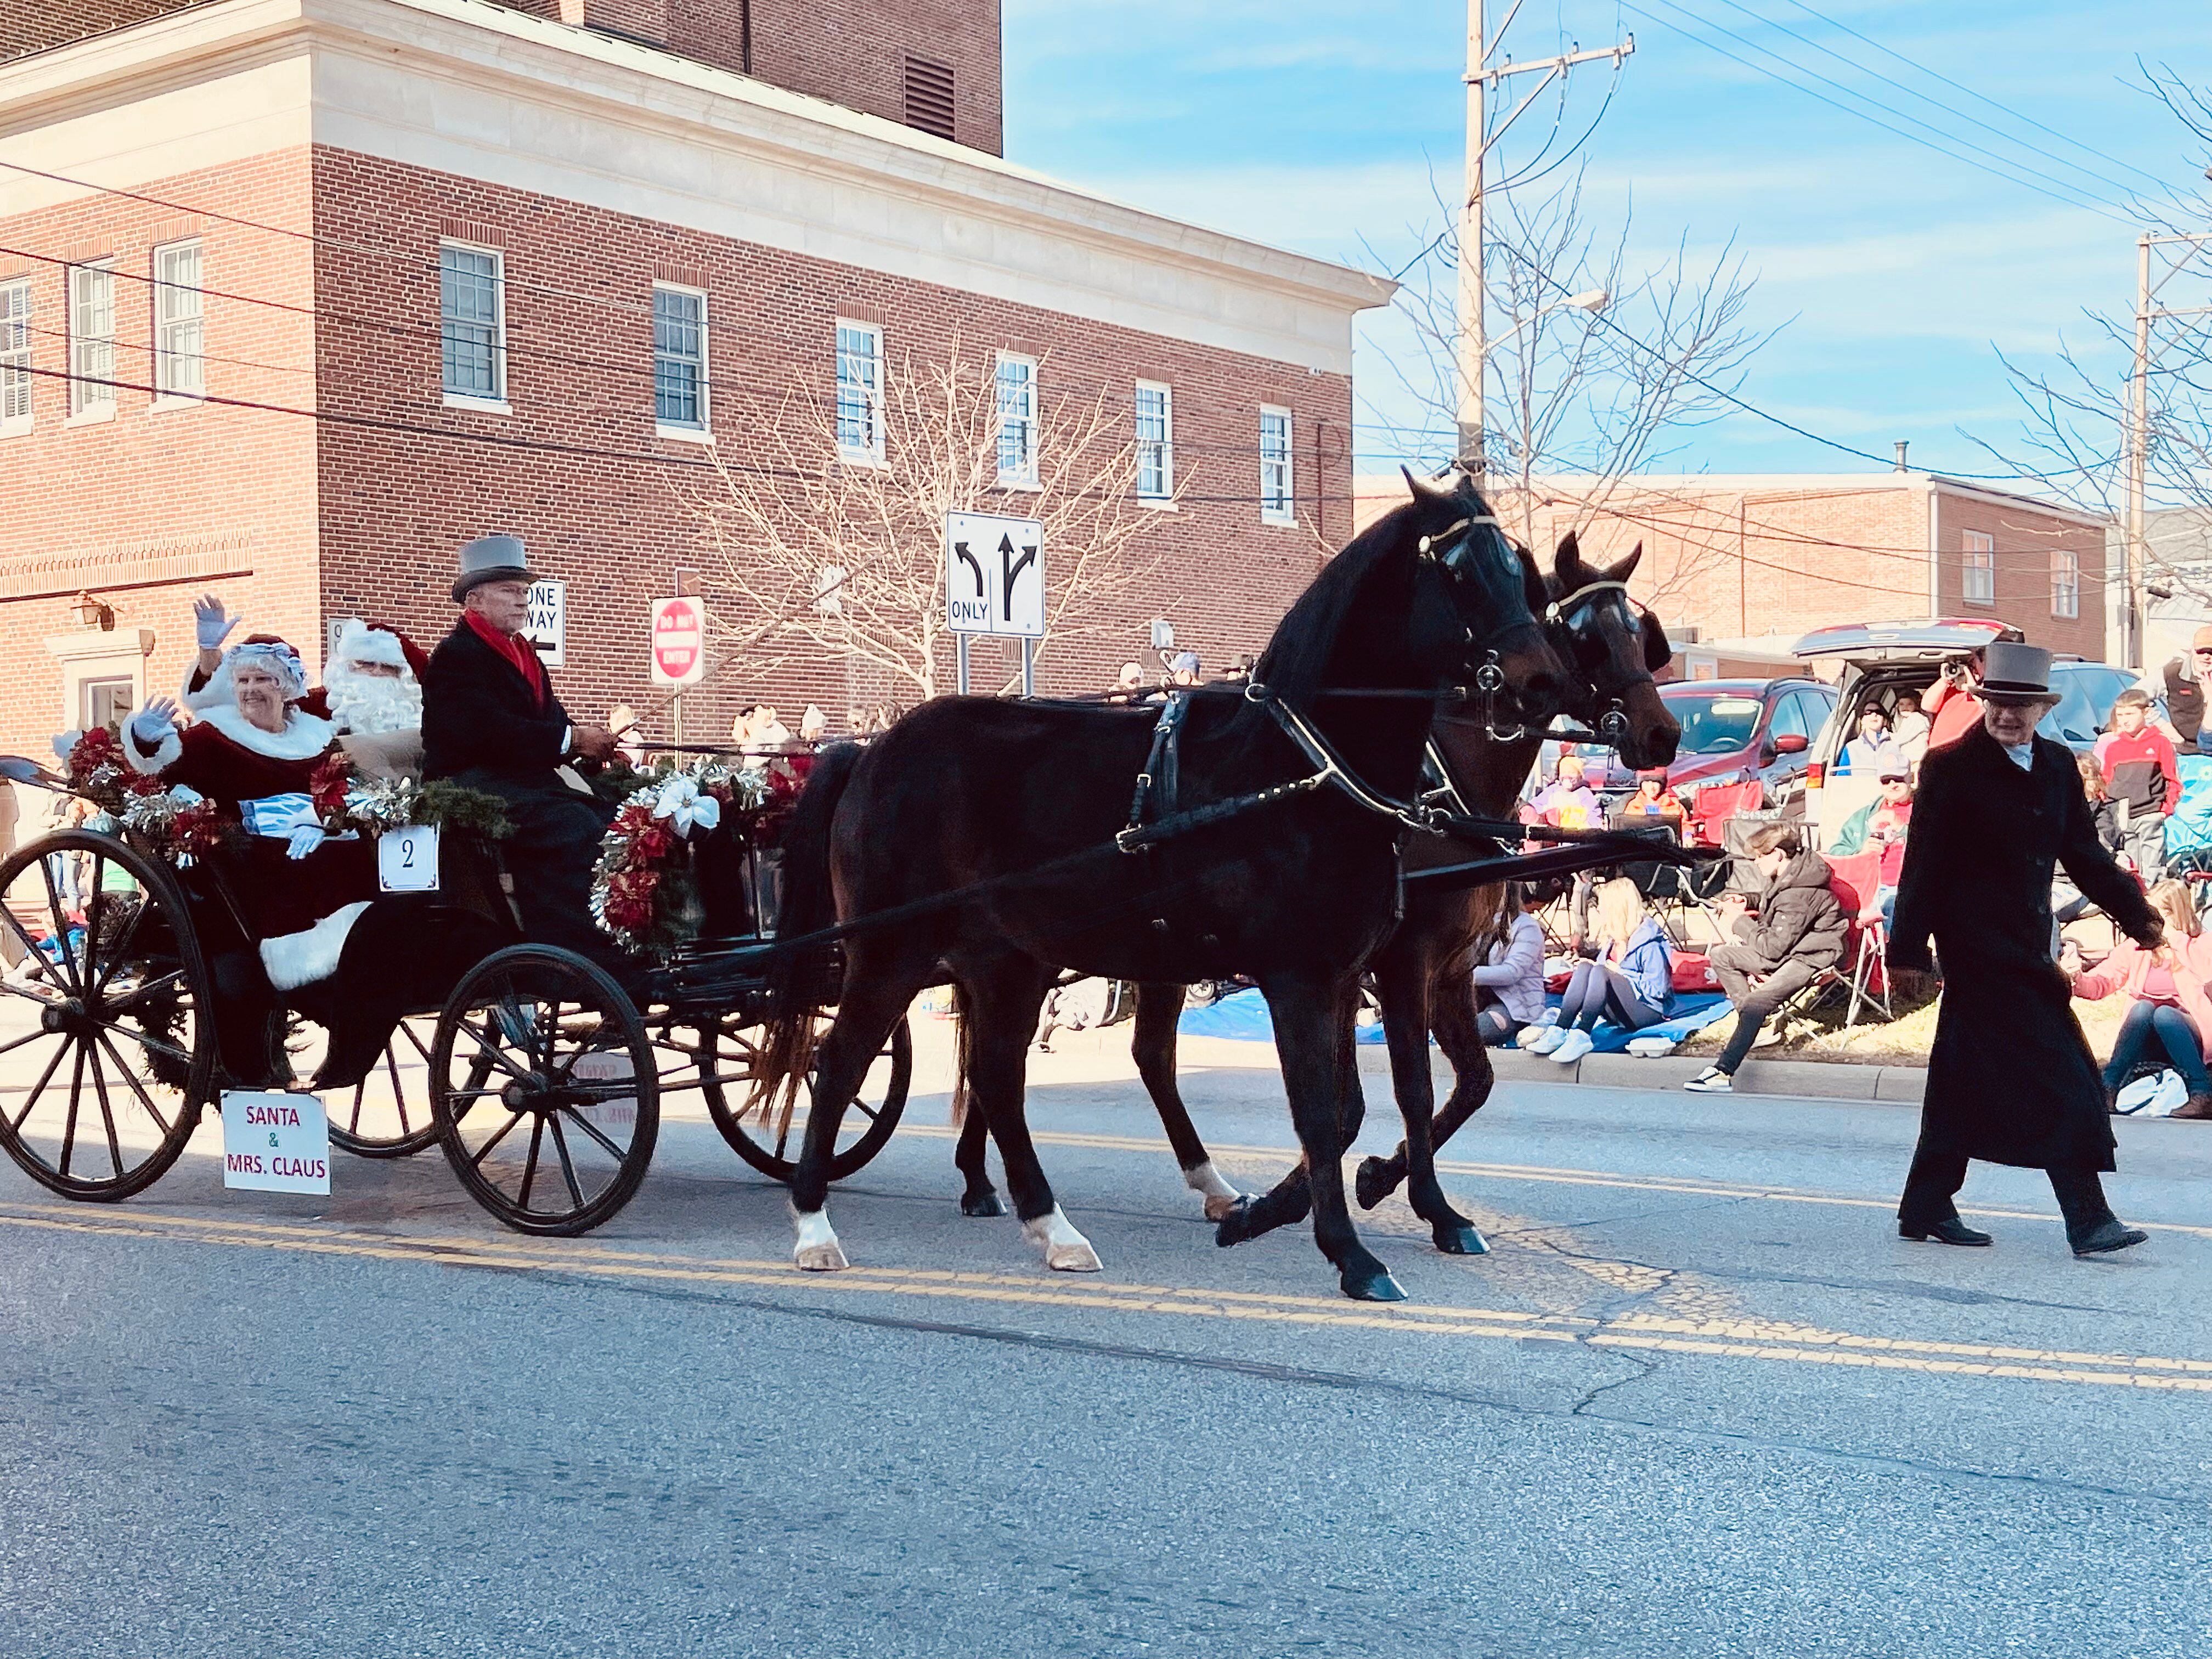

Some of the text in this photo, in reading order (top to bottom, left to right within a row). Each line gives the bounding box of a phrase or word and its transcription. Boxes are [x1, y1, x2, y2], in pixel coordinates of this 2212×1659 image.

[527, 587, 556, 606] ONE
[952, 601, 988, 620] ONLY
[660, 614, 694, 629] DO NOT
[663, 650, 691, 664] ENTER
[402, 839, 414, 868] 2
[246, 1105, 300, 1126] SANTA
[269, 1132, 279, 1147] &
[228, 1154, 325, 1178] MRS. CLAUS
